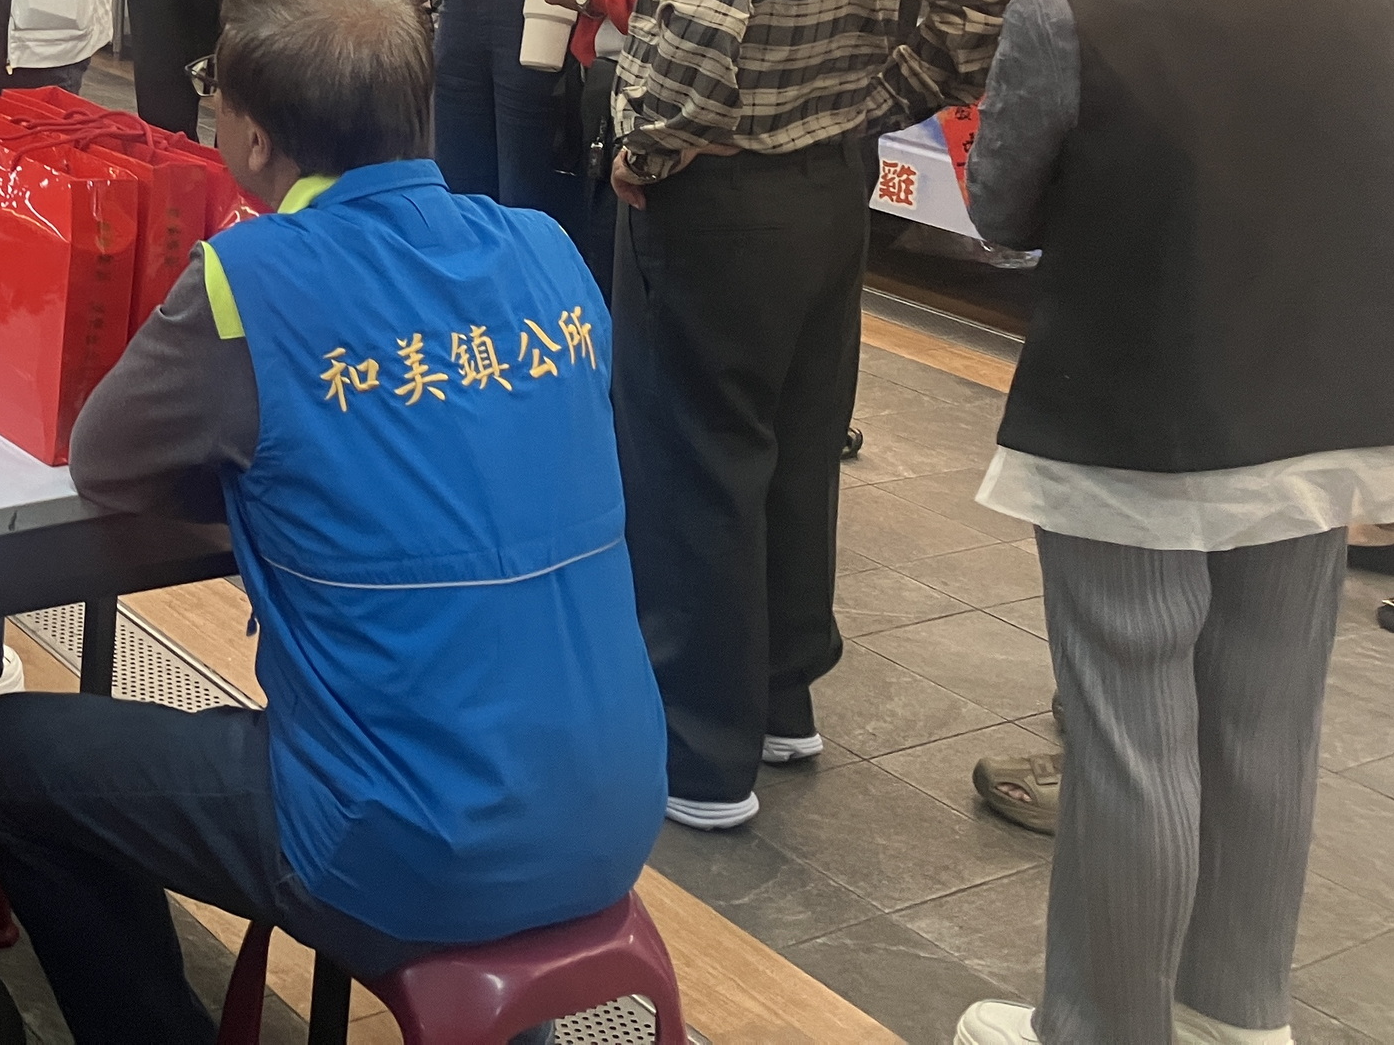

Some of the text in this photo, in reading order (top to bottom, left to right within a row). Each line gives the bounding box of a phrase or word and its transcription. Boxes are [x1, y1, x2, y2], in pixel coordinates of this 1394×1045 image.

[320, 305, 598, 413] 和美鎮公所
